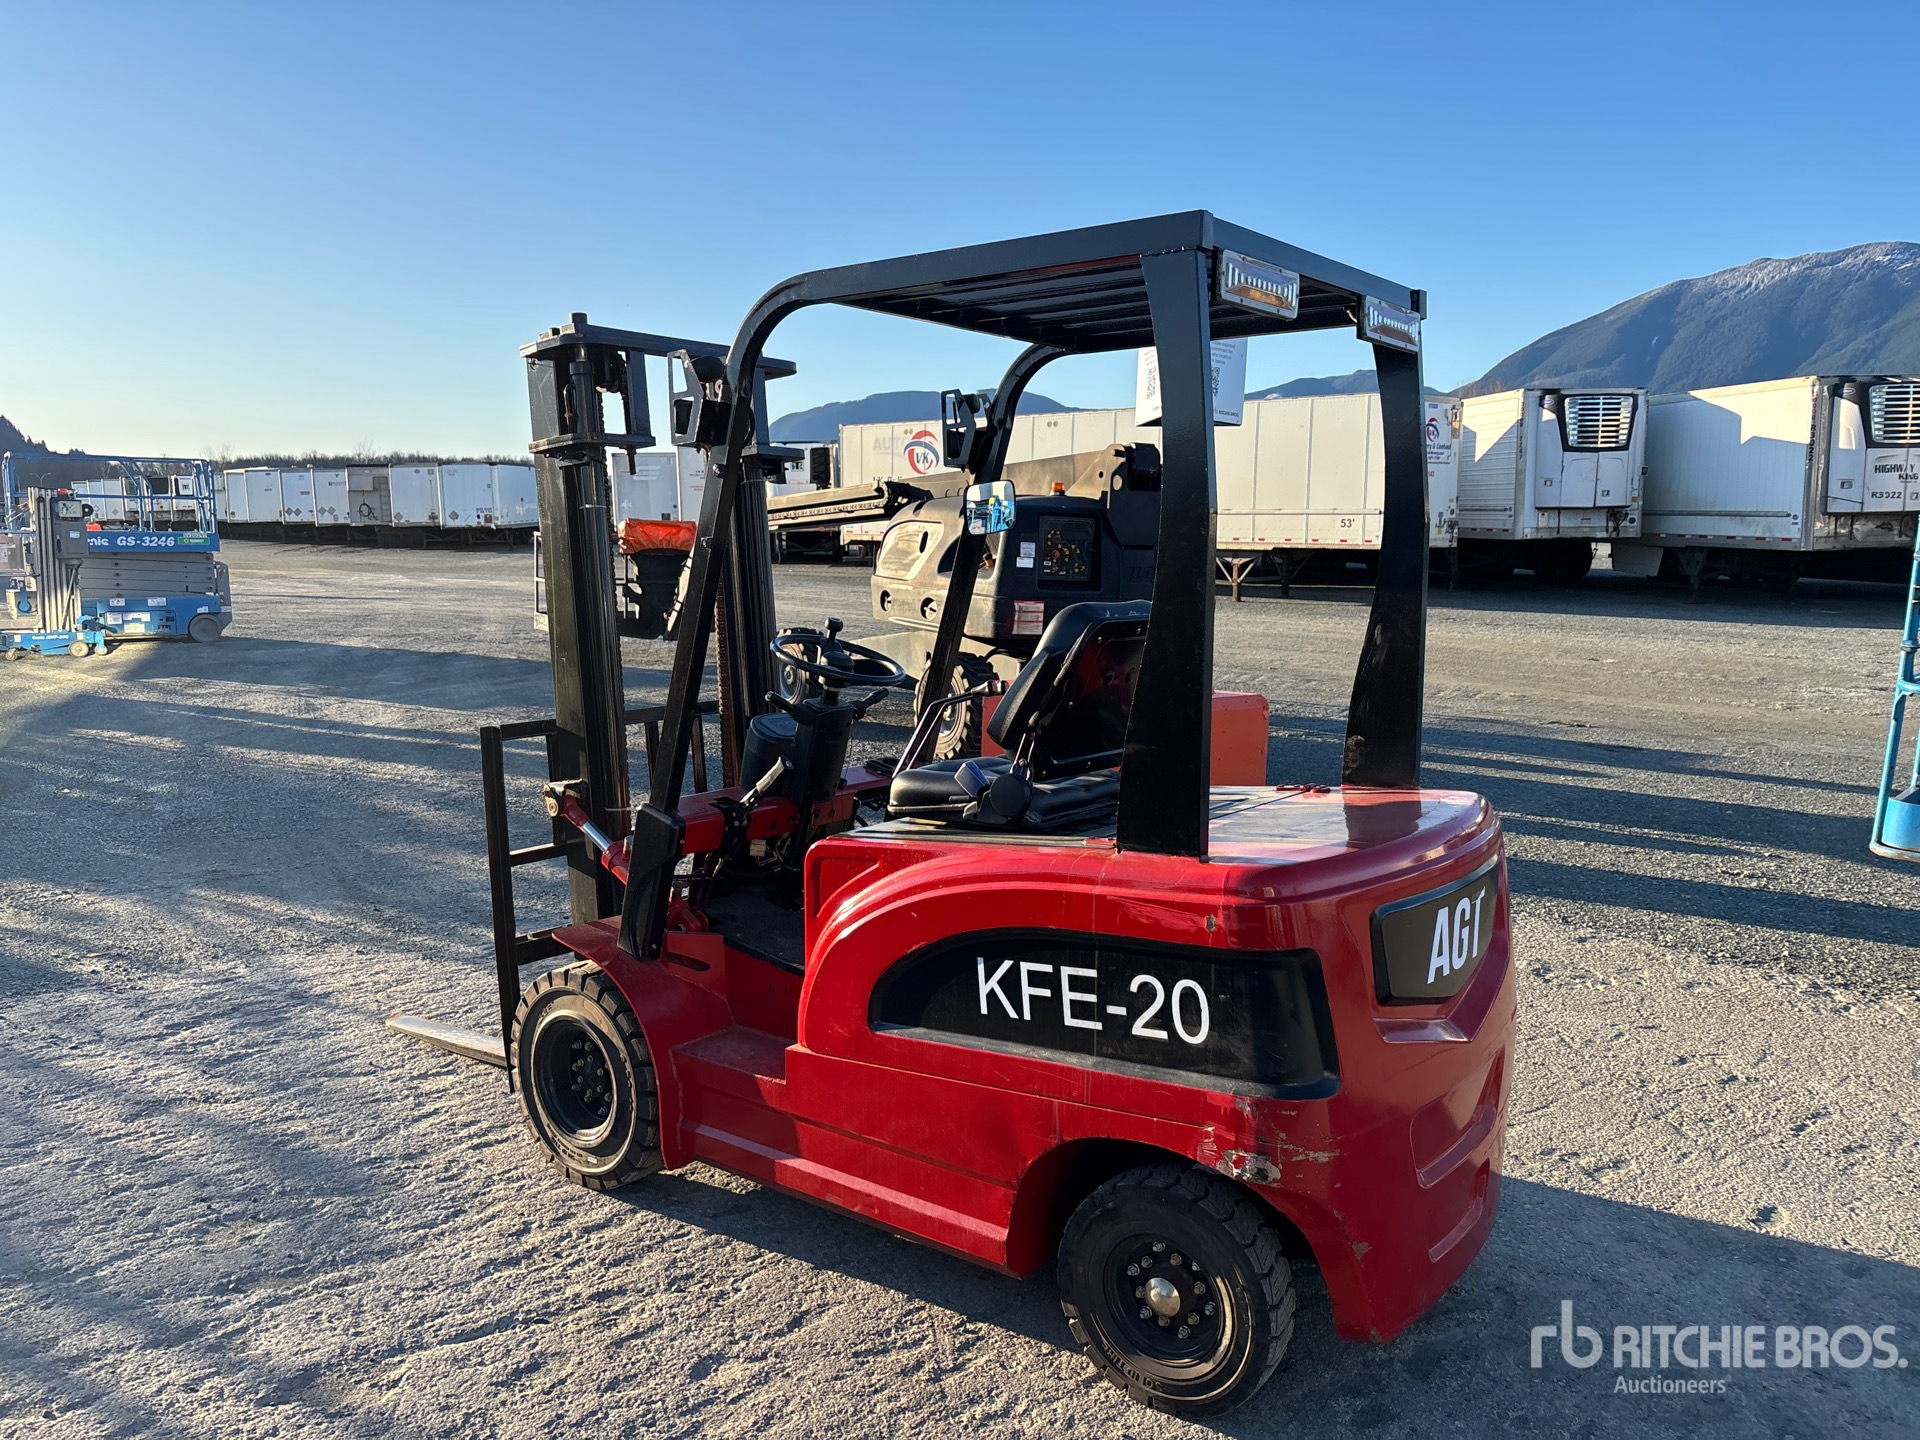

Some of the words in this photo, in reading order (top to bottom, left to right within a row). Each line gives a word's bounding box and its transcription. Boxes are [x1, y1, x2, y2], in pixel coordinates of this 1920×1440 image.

[1808, 424, 1817, 461] R3022
[915, 452, 930, 464] VK
[1871, 491, 1903, 499] R3022
[117, 536, 175, 547] GS-3246
[1427, 886, 1487, 985] AGT
[975, 956, 1210, 1045] KFE-20
